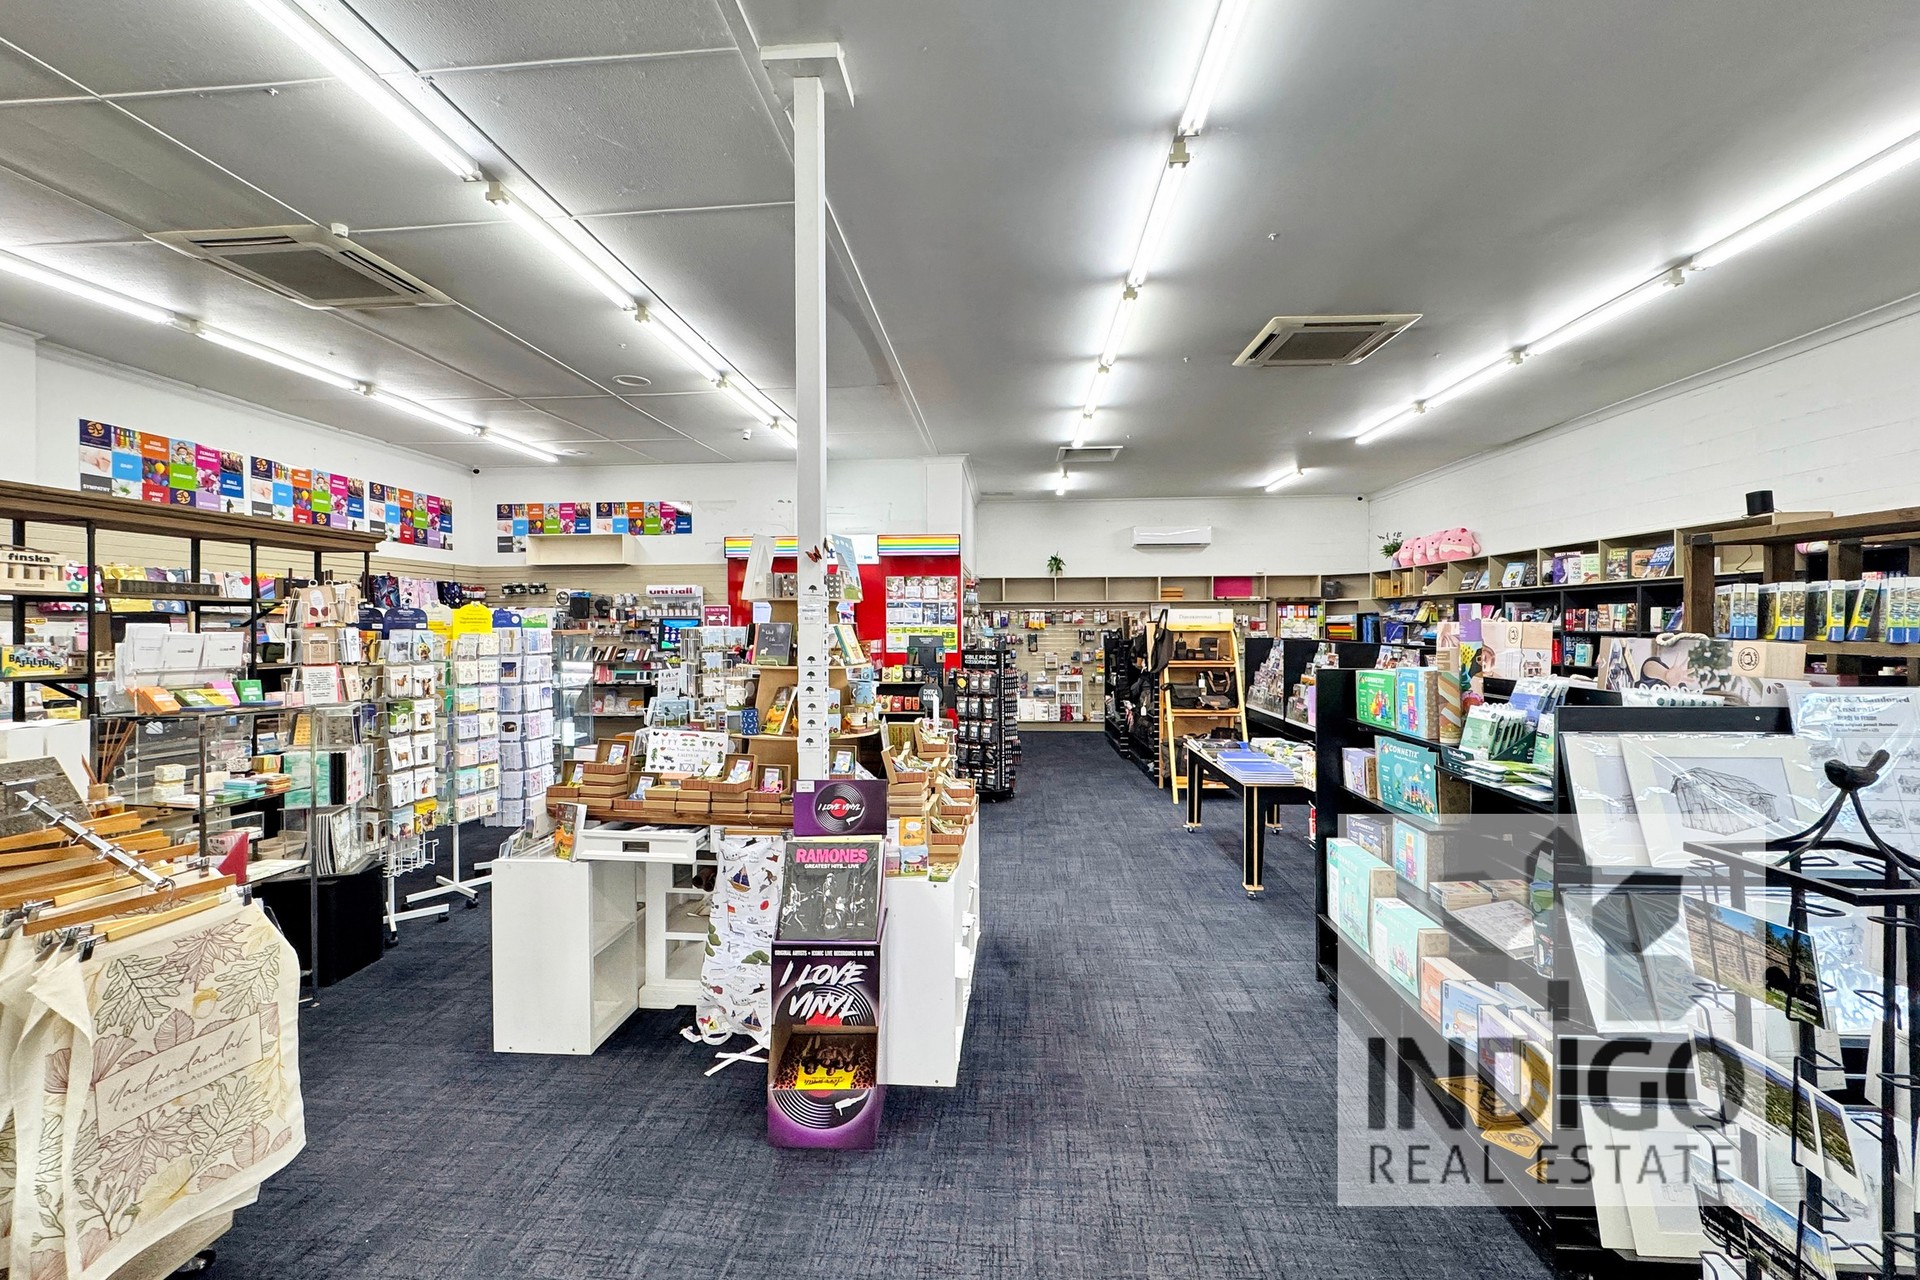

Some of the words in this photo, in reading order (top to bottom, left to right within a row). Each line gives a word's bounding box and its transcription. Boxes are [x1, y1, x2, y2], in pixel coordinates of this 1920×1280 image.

[82, 483, 111, 493] SYMPATHY
[8, 552, 51, 563] finska
[8, 654, 61, 671] BAJILLIONS
[1389, 744, 1419, 759] CONNETIX
[822, 803, 841, 811] LOVE
[842, 803, 861, 811] VINYL
[795, 848, 868, 863] RAMONES
[779, 960, 794, 987] I
[795, 960, 869, 991] LOVE
[788, 990, 860, 1020] VINYL
[191, 1056, 237, 1080] AUSTRALIA
[1446, 1081, 1475, 1093] NEXT
